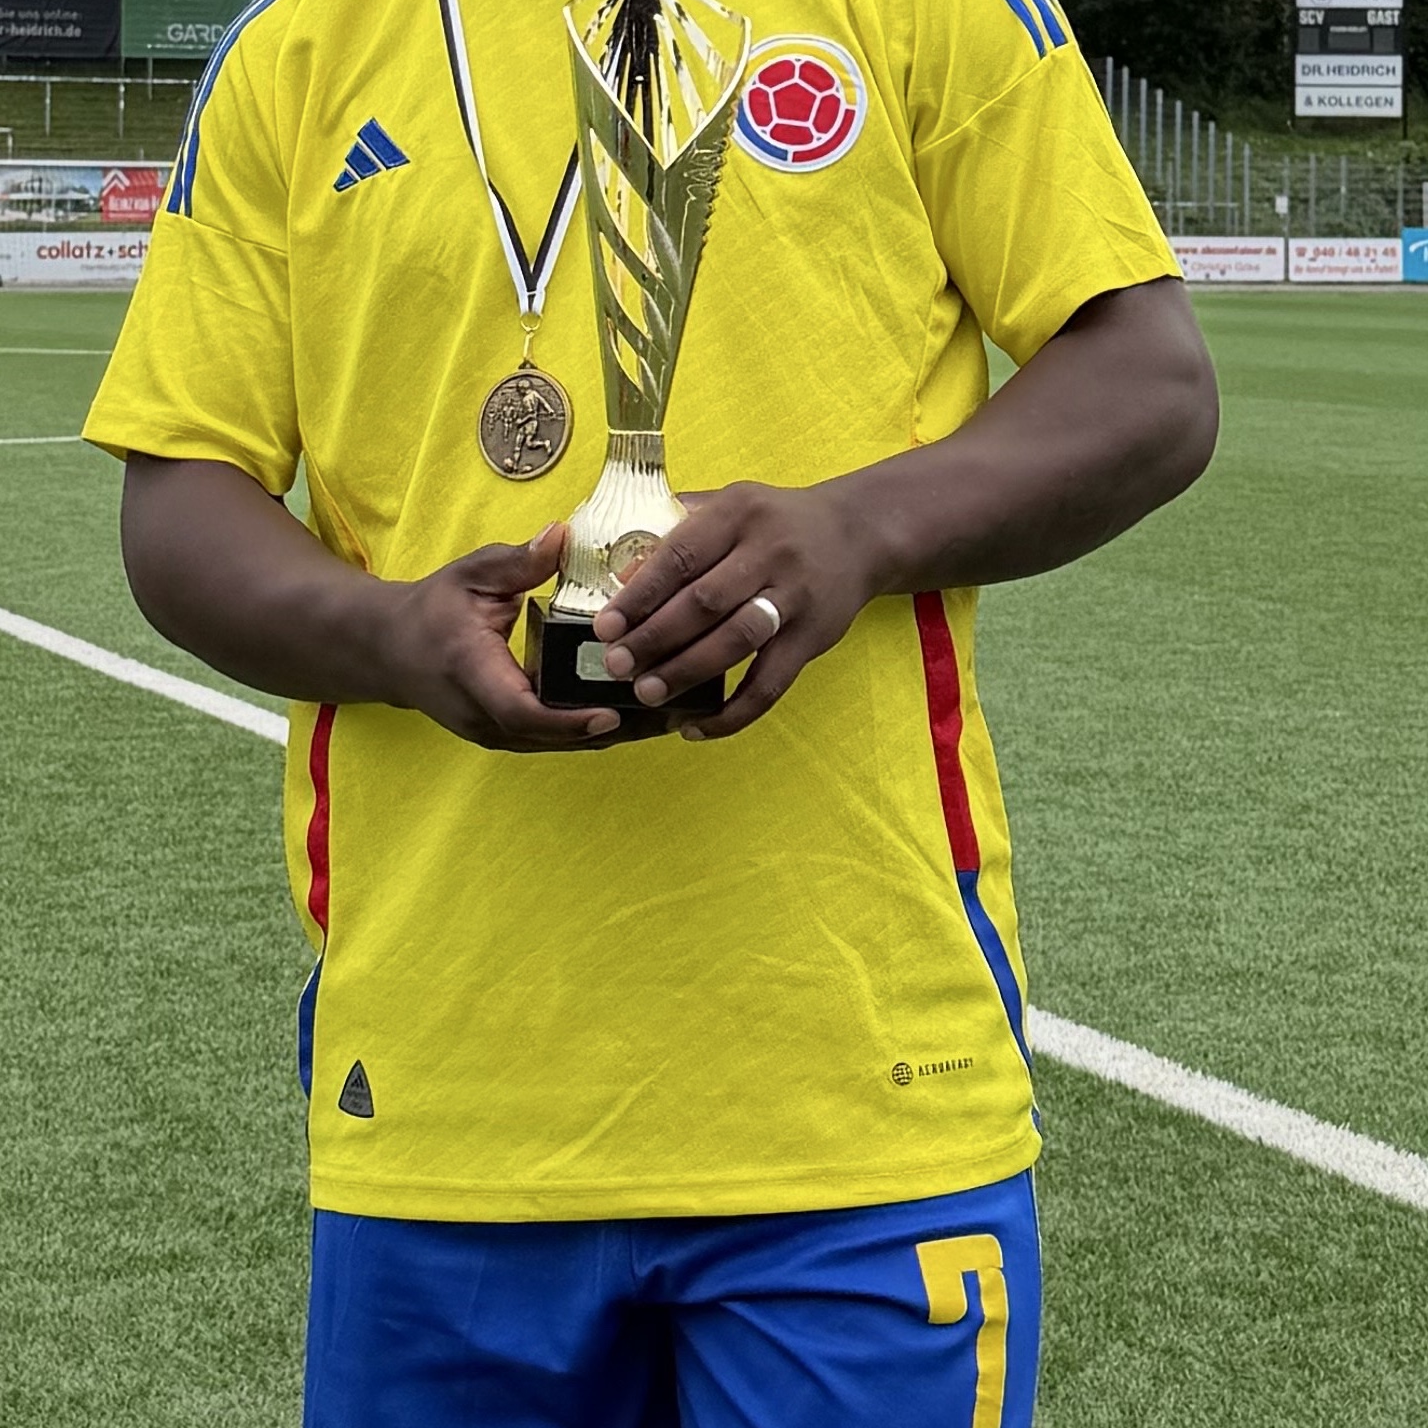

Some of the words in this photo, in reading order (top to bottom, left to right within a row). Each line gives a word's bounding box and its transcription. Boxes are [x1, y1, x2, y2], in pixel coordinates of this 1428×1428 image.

[1299, 10, 1324, 25] SCV
[1367, 10, 1400, 25] GAST
[1326, 64, 1396, 77] HEIDRICH
[1317, 95, 1394, 108] KOLLEGEN
